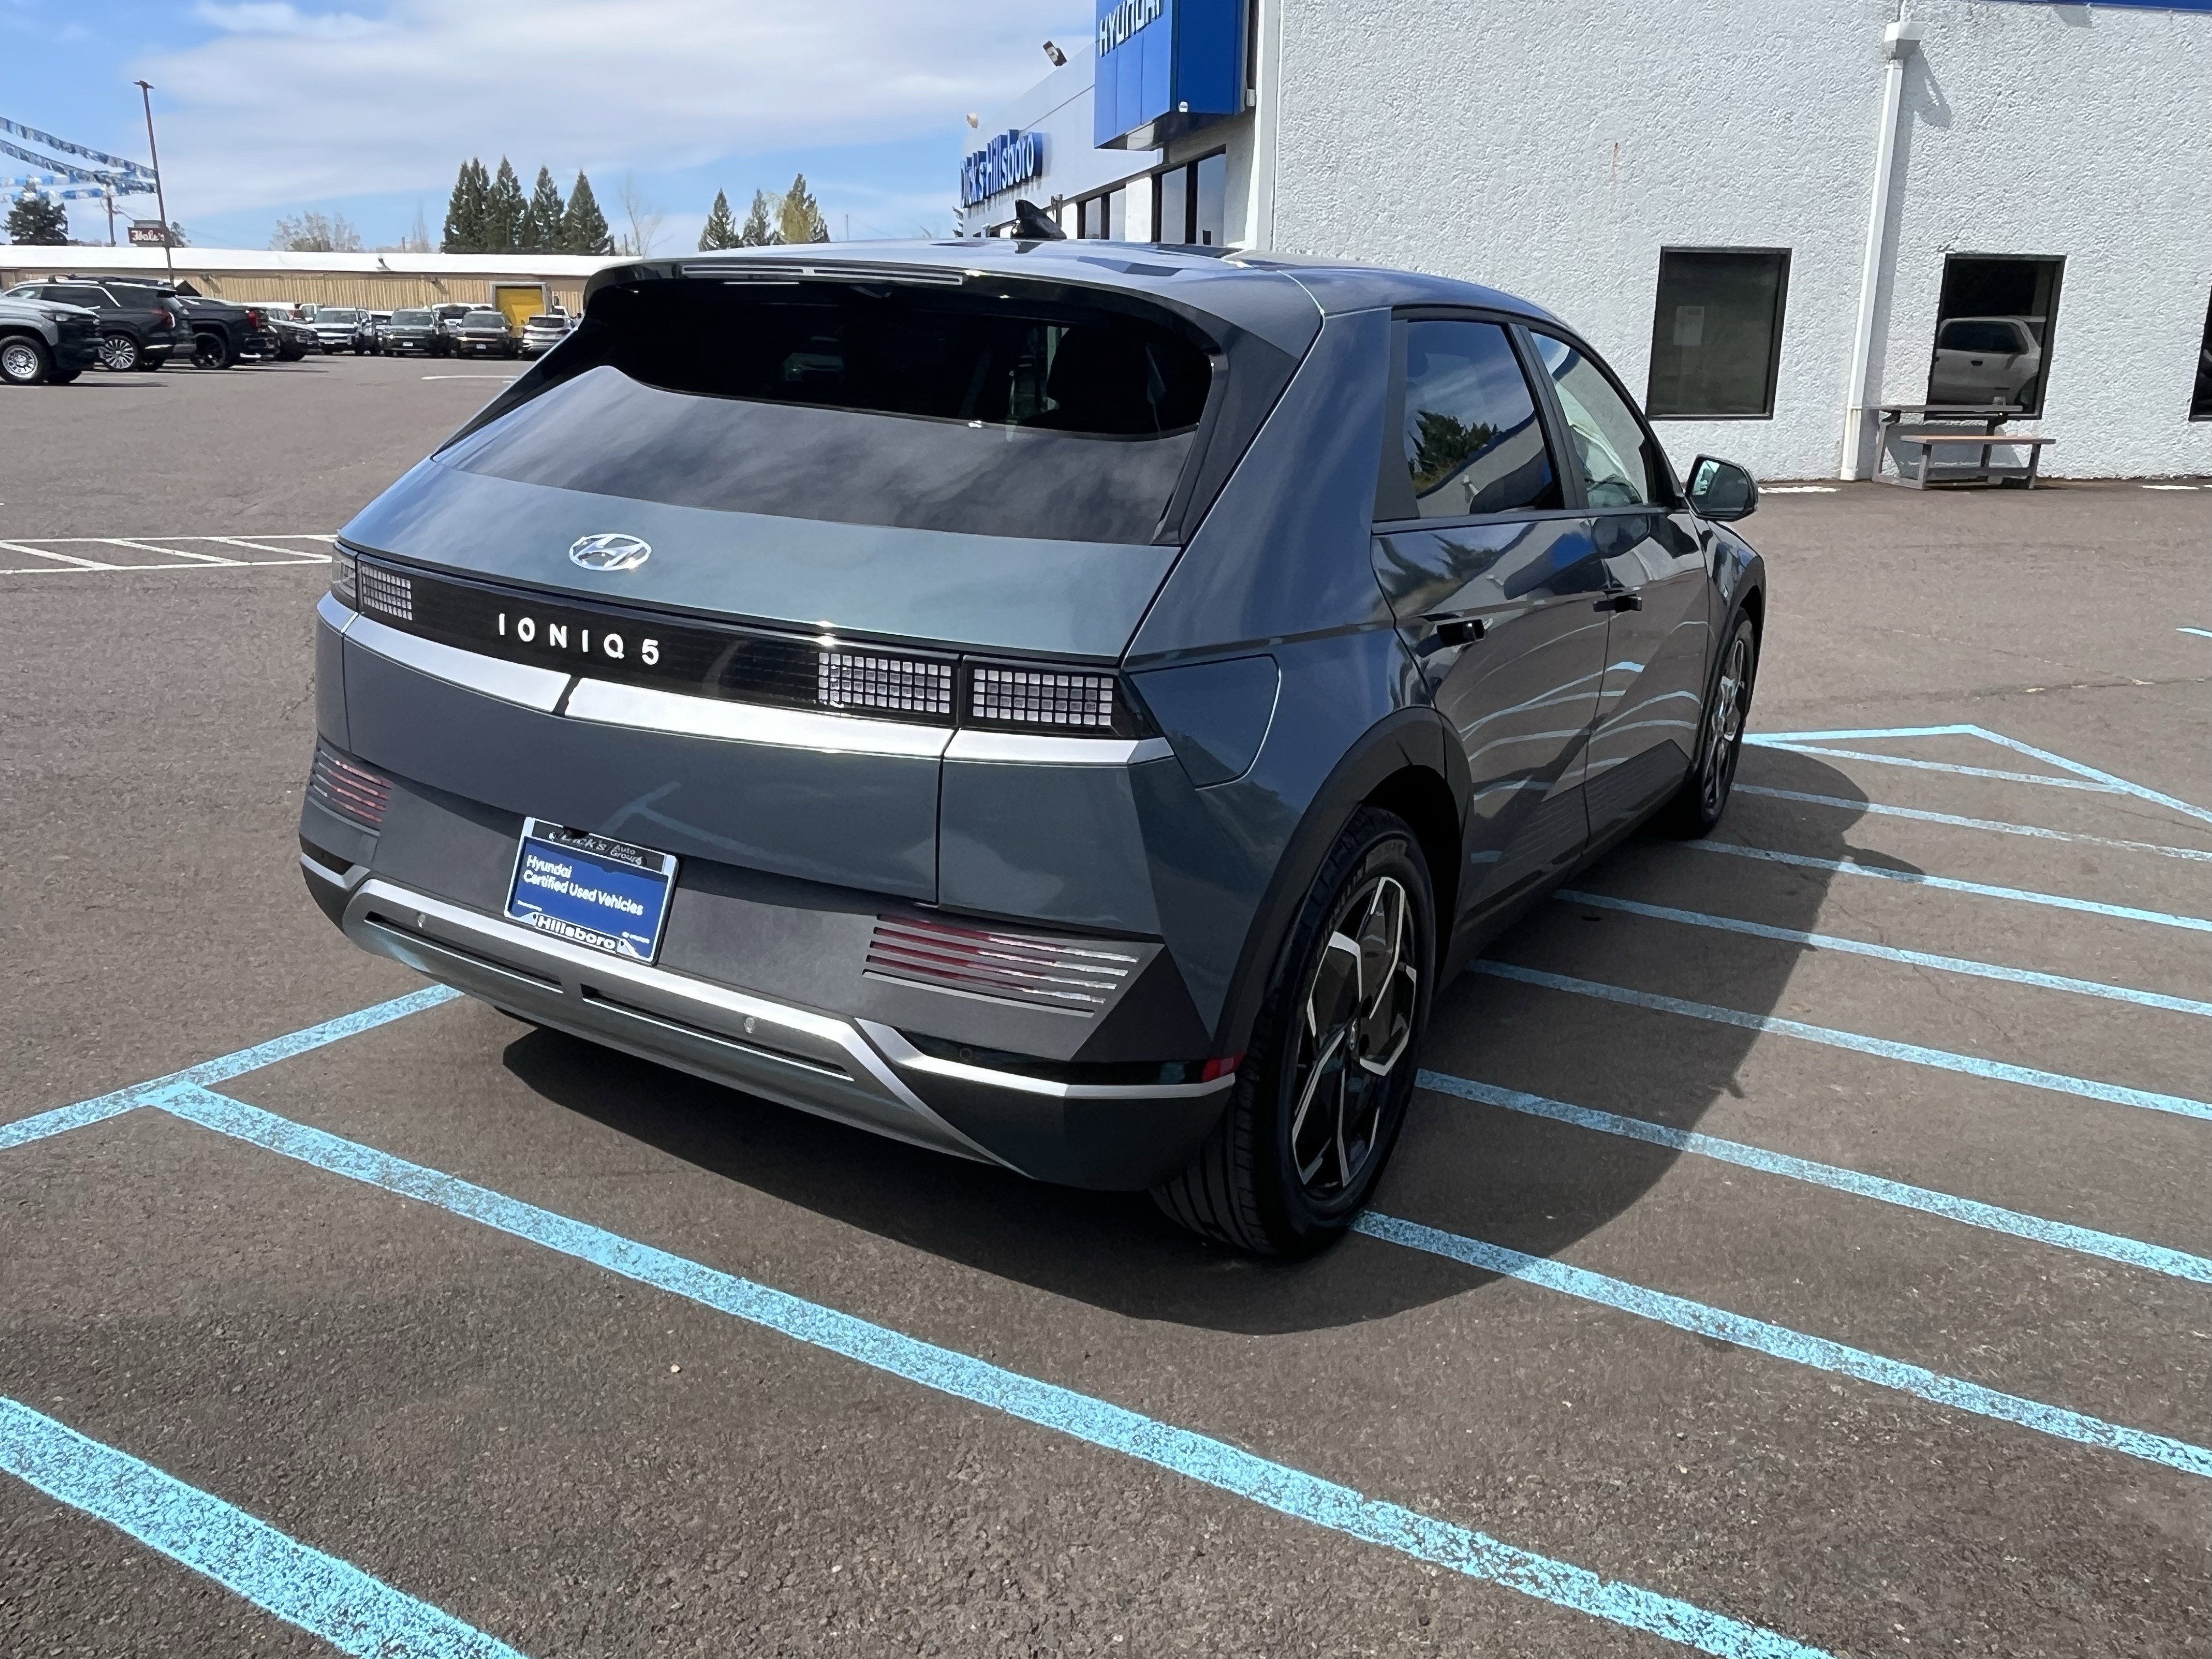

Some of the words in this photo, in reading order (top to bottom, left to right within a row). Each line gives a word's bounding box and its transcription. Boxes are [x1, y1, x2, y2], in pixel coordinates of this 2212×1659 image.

[986, 129, 1035, 196] Hillsboro
[498, 613, 625, 659] IONIQ
[641, 639, 659, 665] 5
[526, 854, 573, 878] Hyundai
[523, 870, 568, 894] Certified
[568, 882, 597, 902] Used
[597, 891, 644, 916] Vehicles
[538, 916, 617, 950] Hillsboro
